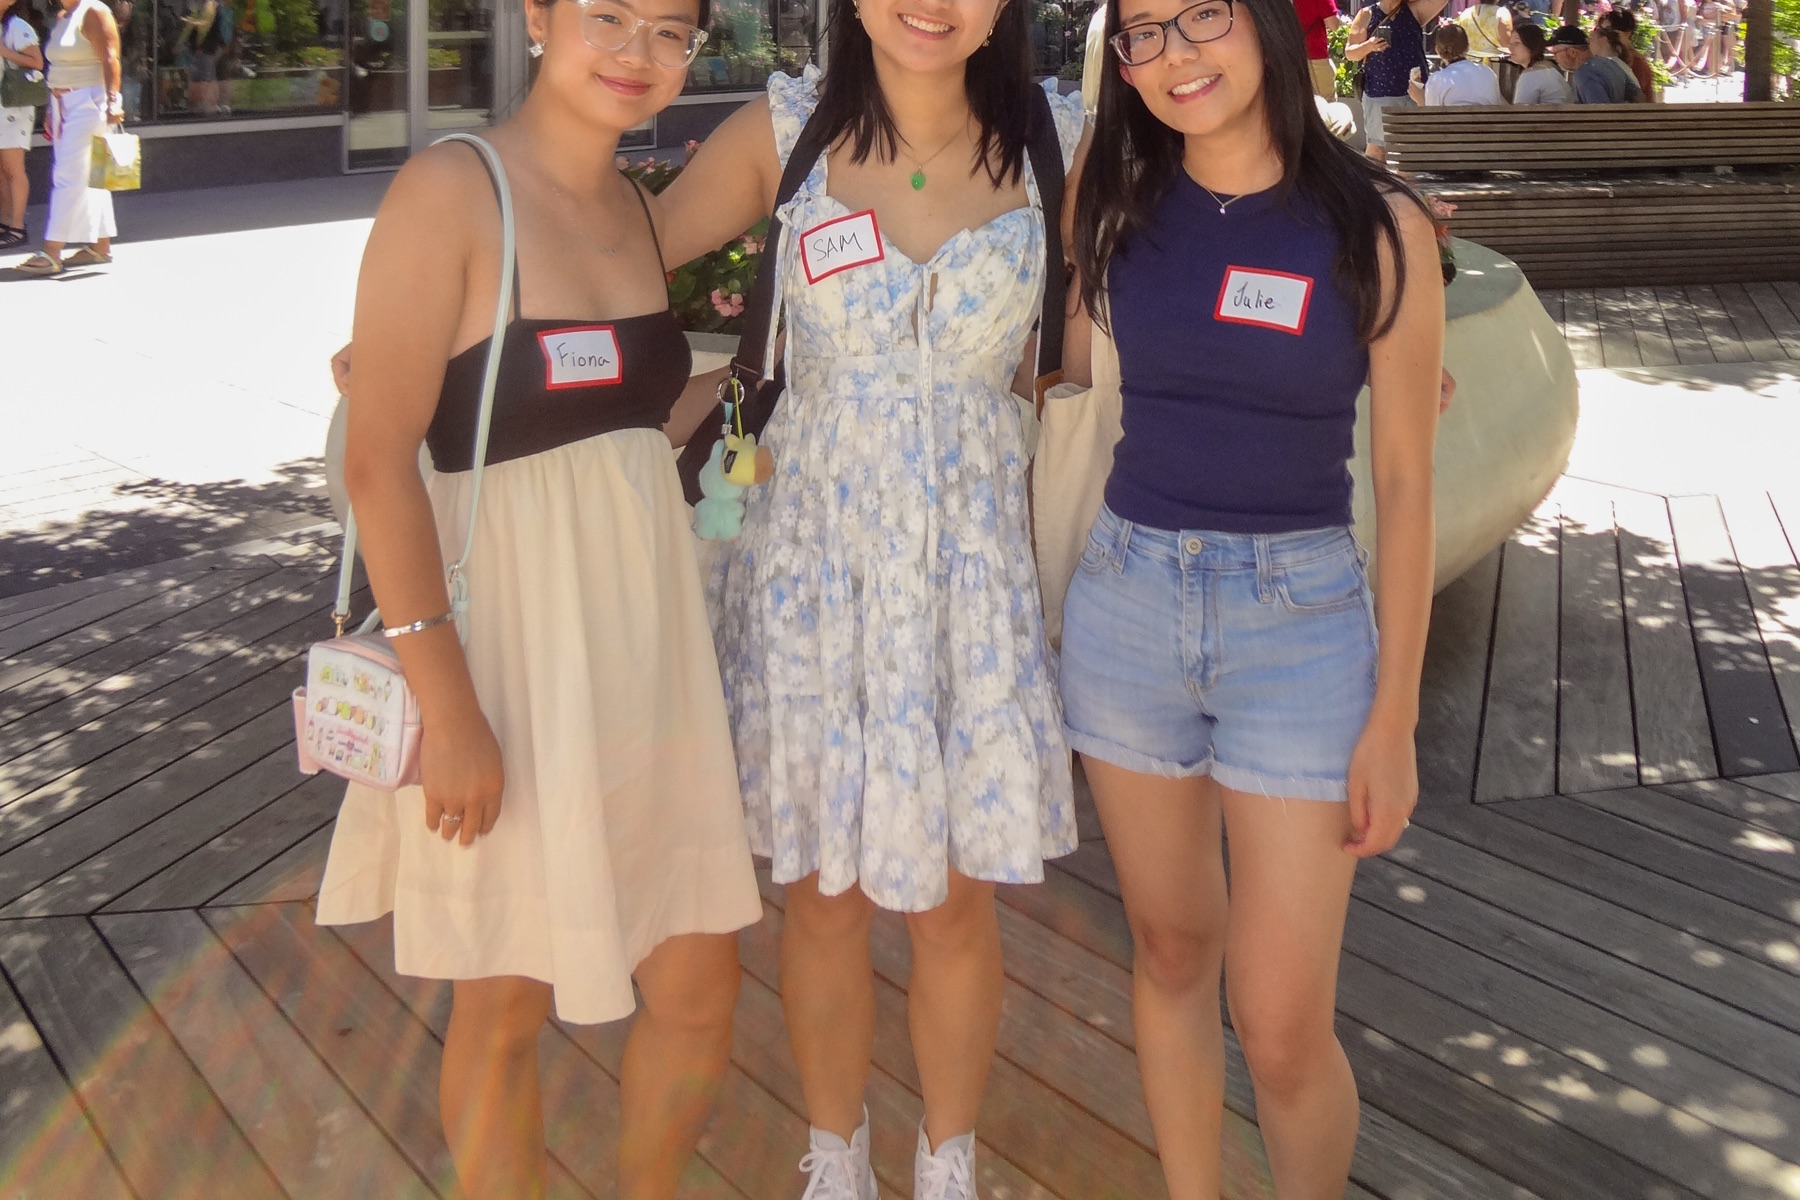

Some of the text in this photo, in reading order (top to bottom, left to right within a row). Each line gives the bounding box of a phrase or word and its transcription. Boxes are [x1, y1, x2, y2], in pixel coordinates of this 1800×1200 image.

[812, 231, 864, 262] SAM
[1233, 281, 1276, 310] Julie
[556, 341, 611, 368] Fiona
